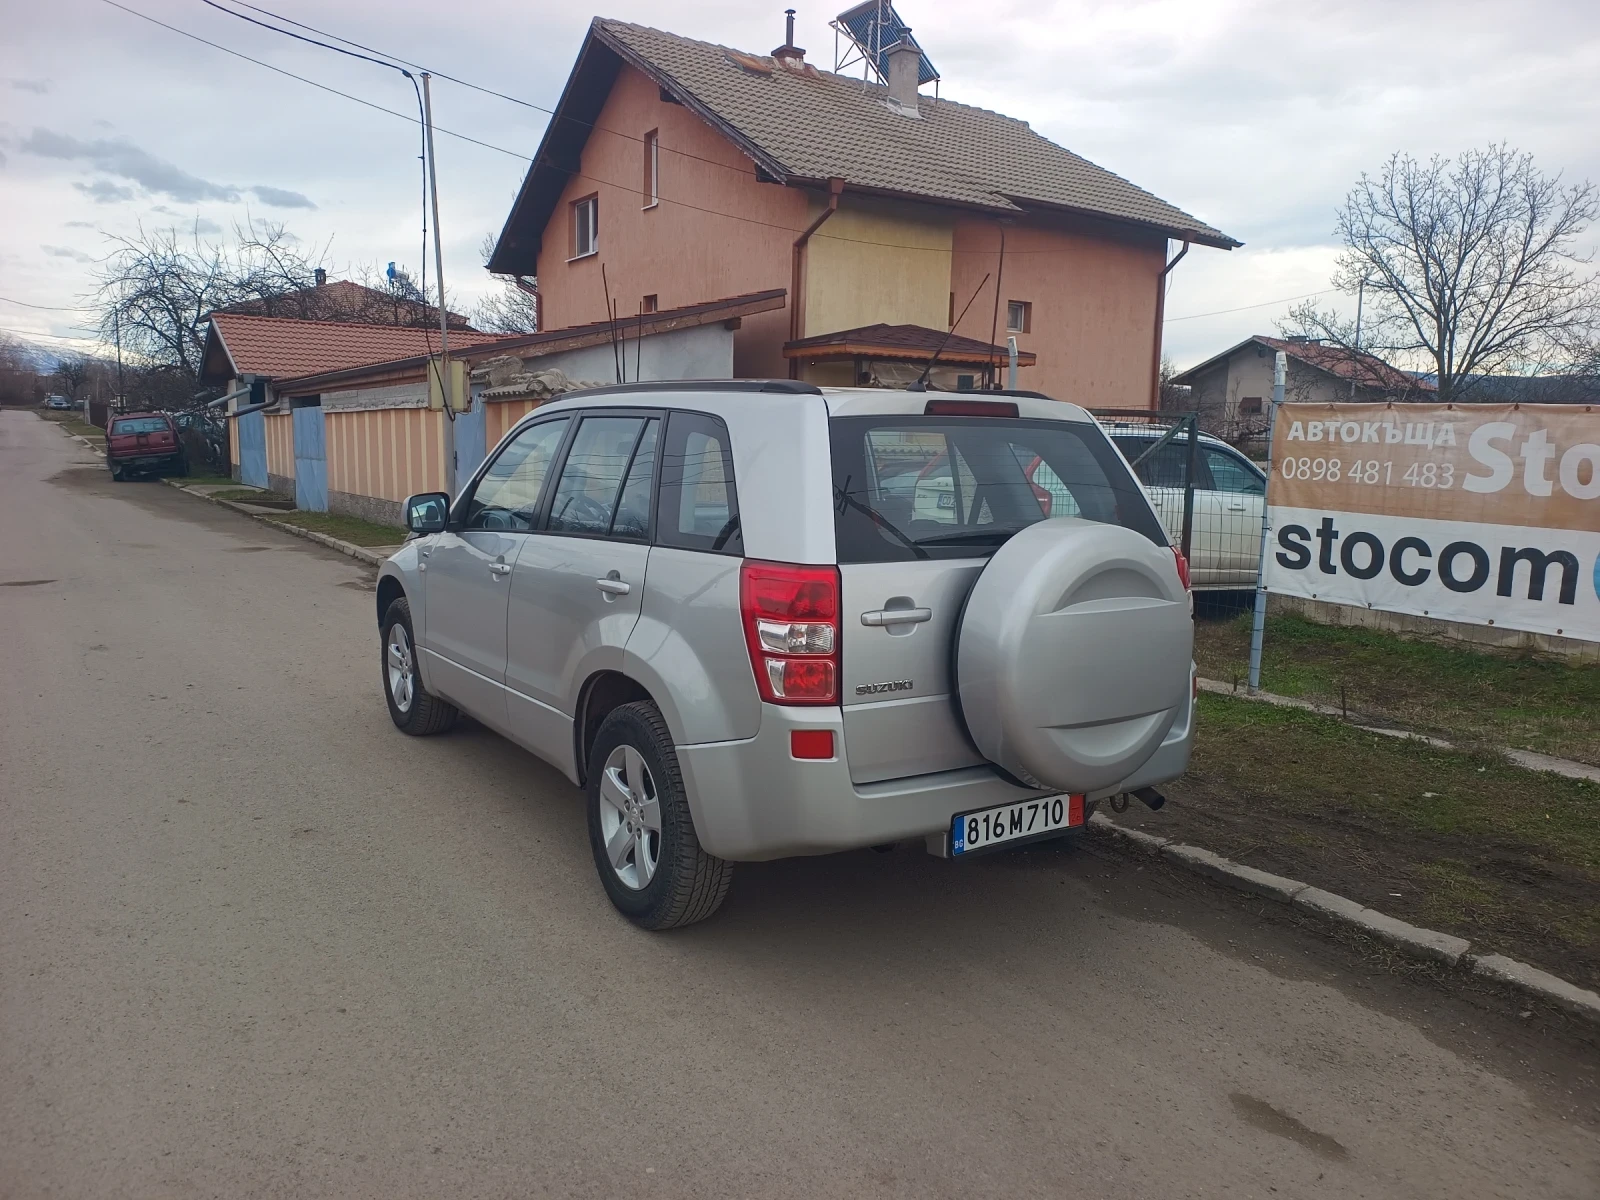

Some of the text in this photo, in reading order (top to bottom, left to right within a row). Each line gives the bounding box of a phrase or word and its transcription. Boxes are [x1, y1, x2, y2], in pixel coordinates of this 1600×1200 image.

[1287, 421, 1457, 450] АВТОКЪЩА
[1281, 456, 1455, 489] 0898 481 483
[1275, 517, 1580, 606] stocom
[856, 679, 913, 695] SUZUKI
[954, 838, 964, 850] BG
